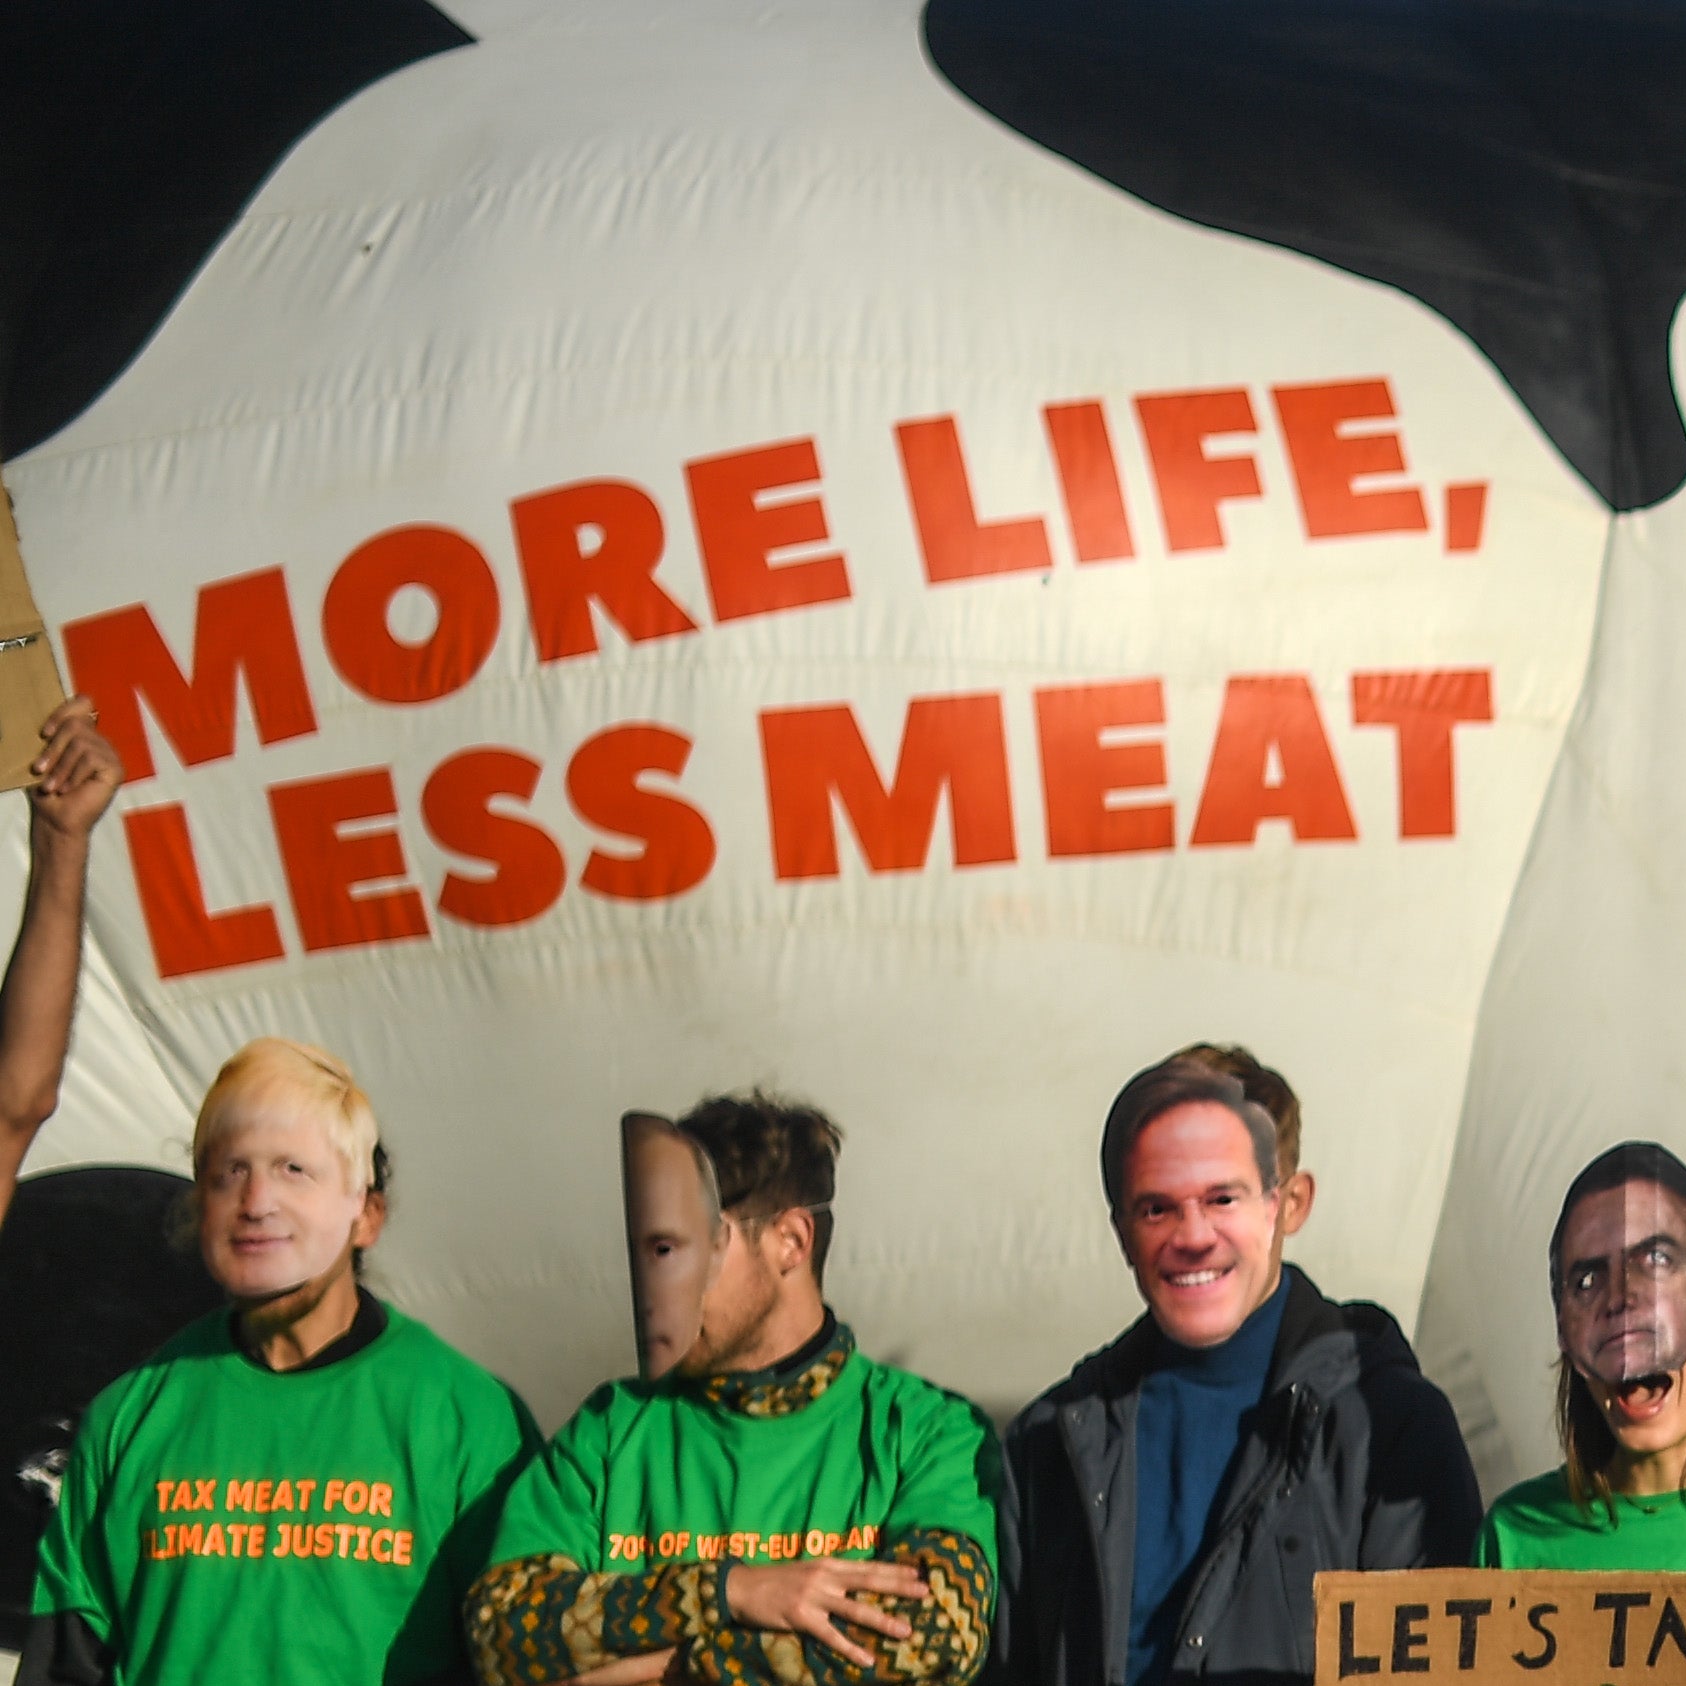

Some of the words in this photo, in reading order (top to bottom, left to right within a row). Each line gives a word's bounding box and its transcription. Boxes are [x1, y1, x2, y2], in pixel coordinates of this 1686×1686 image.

[61, 435, 853, 786] MORE
[894, 376, 1491, 587] LIFE,
[122, 720, 718, 980] LESS
[758, 665, 1495, 883] MEAT
[156, 1478, 217, 1514] TAX
[225, 1478, 318, 1514] MEAT
[323, 1479, 393, 1518] FOR
[145, 1522, 267, 1561] LIMATE
[272, 1522, 415, 1566] JUSTICE
[658, 1531, 691, 1558] OF
[1337, 1594, 1560, 1681] LET'S
